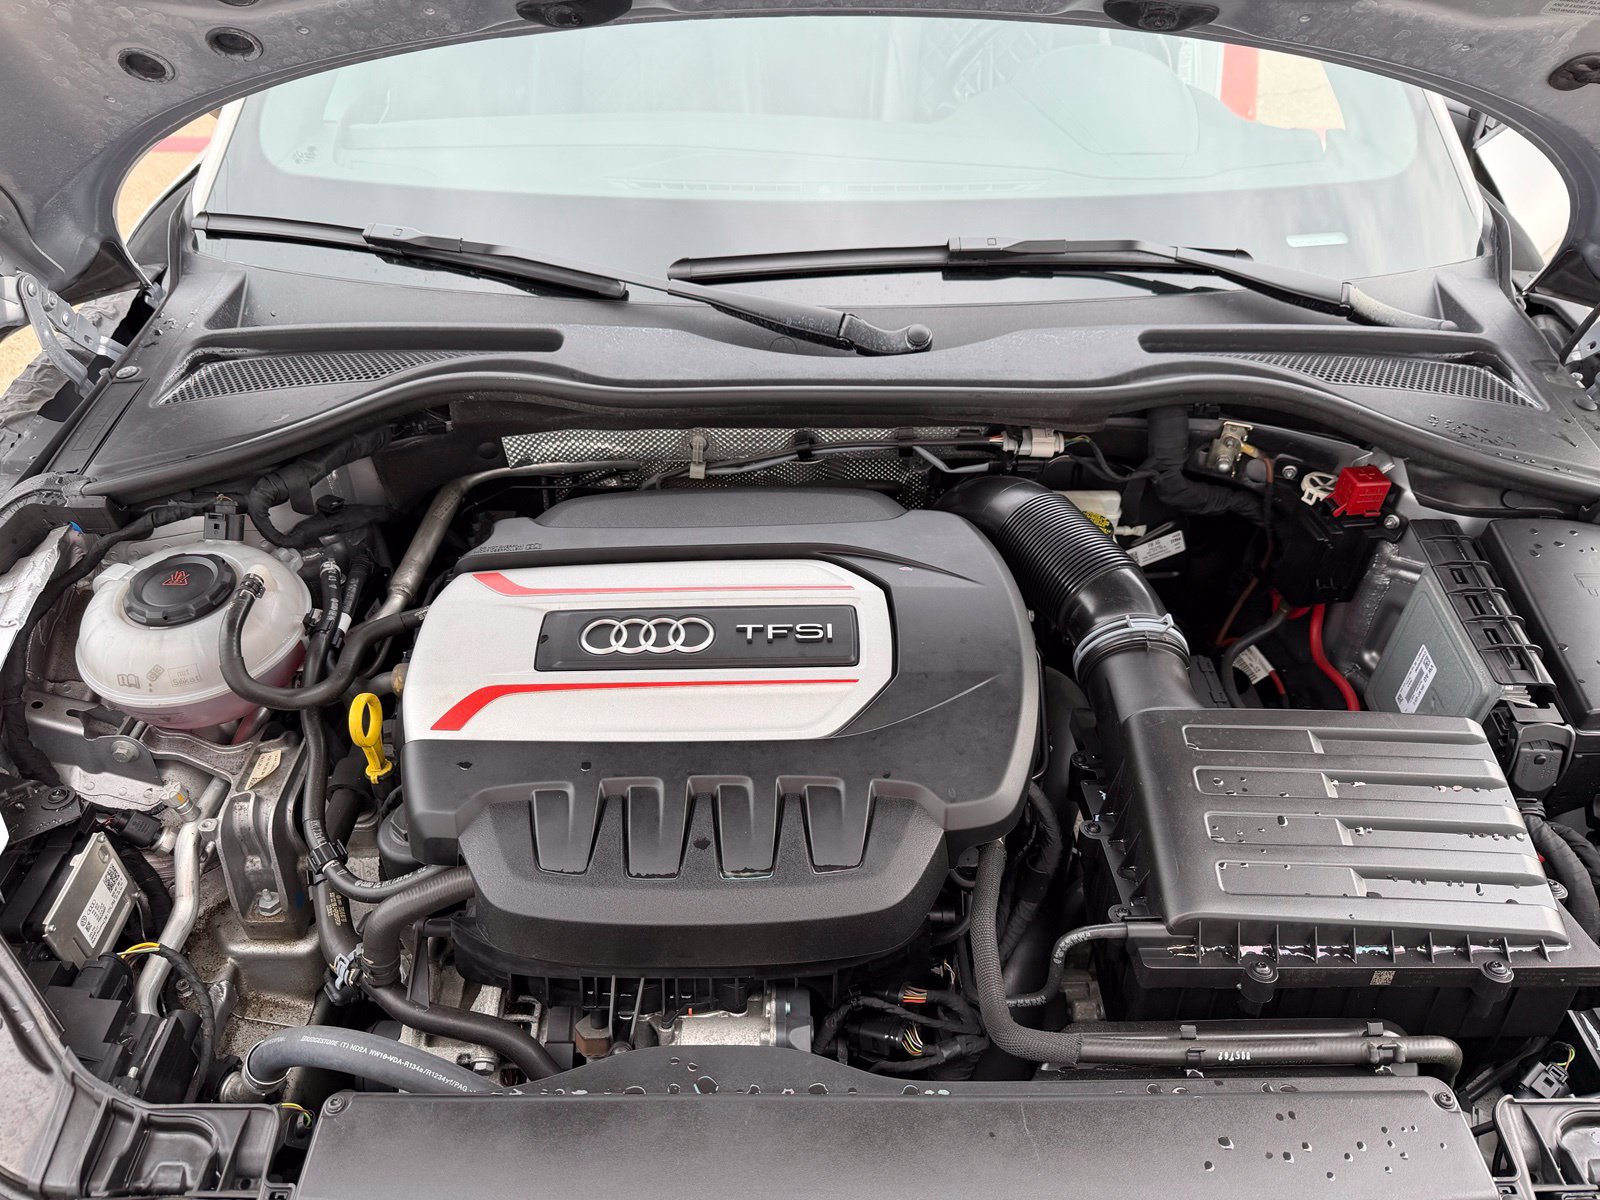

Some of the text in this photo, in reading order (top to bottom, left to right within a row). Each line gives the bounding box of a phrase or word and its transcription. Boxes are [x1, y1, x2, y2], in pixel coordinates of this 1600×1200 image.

[736, 623, 833, 642] TFSI
[300, 1035, 340, 1047] BRIDGESTONE
[340, 1041, 350, 1050] (T)
[350, 1044, 368, 1054] ND2A
